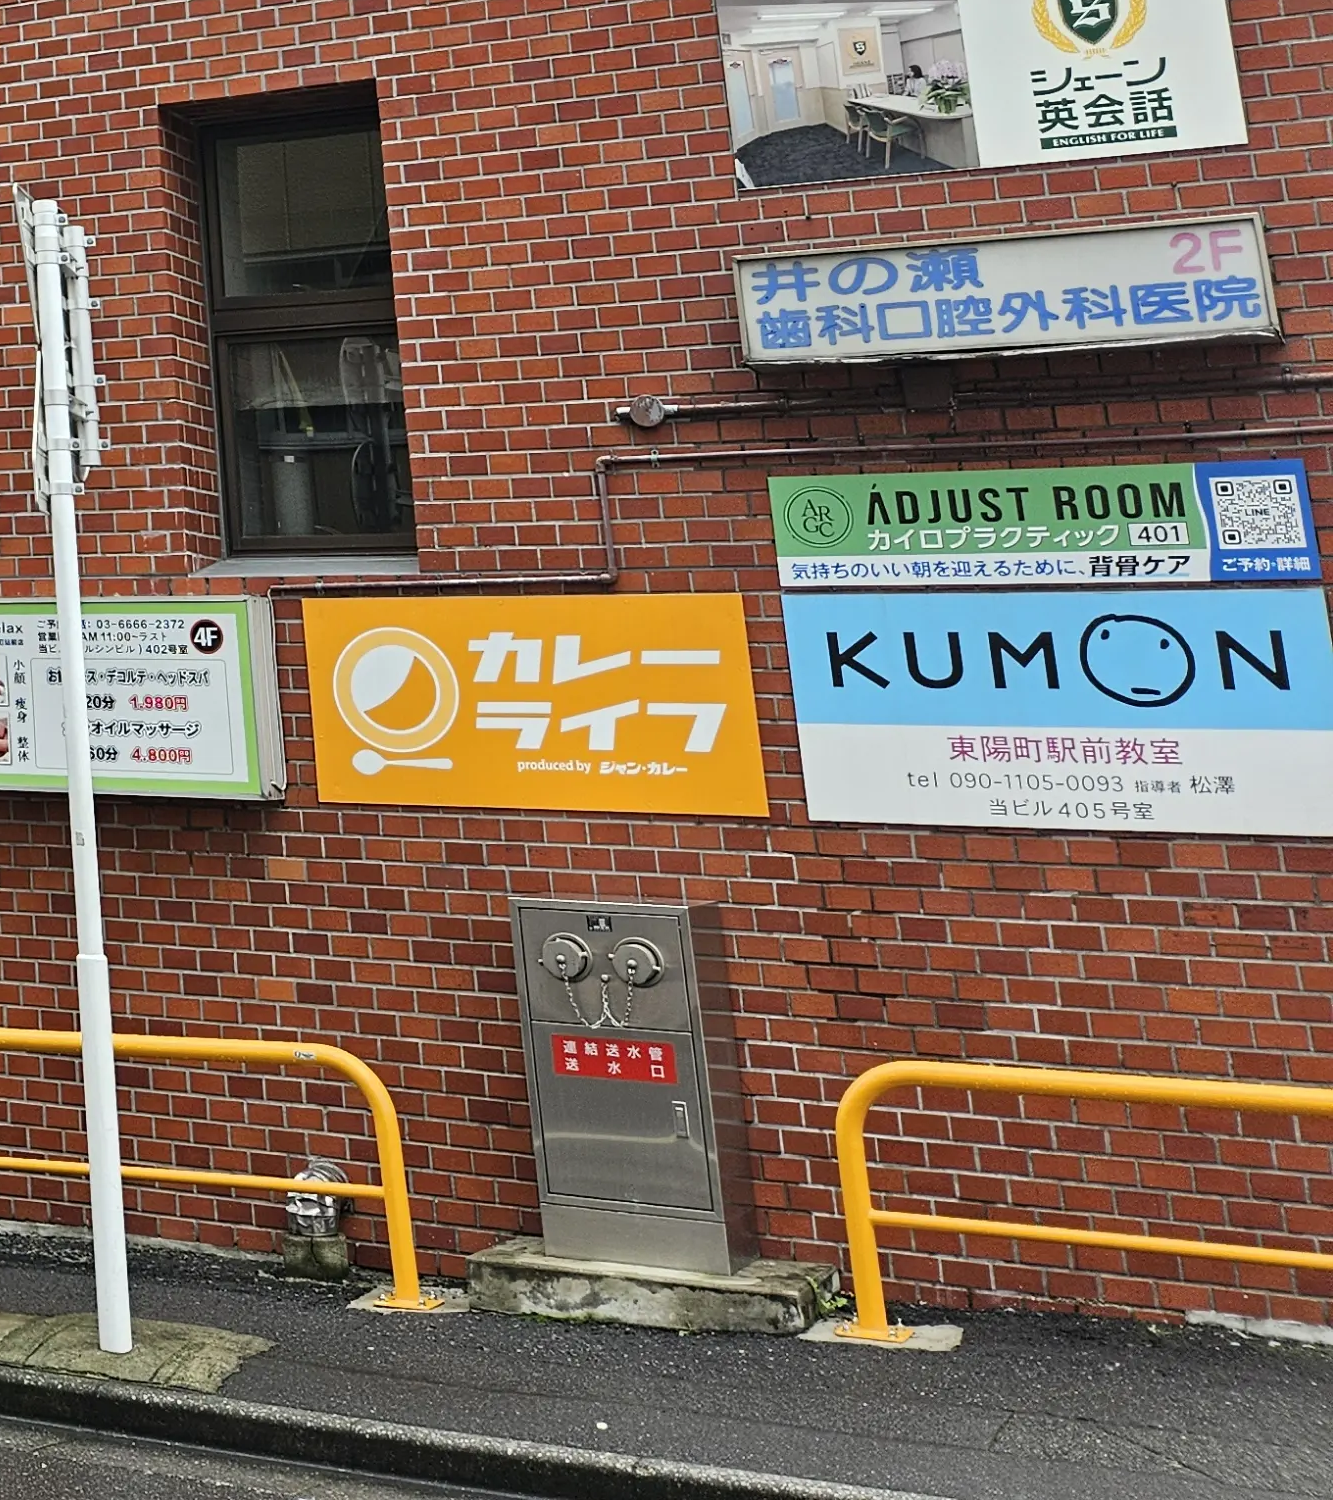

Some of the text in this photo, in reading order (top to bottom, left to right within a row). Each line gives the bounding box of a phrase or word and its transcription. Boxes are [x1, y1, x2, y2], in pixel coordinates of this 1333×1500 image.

[1030, 56, 1167, 97] シェーン
[1035, 87, 1174, 134] 英会話
[1052, 128, 1166, 148] ENGLISH FOR LIFE
[750, 228, 1245, 304] 井の瀬 2F
[760, 276, 1262, 350] 歯科口腔外科医院
[1052, 482, 1186, 521] ROOM
[1244, 507, 1271, 517] LINE
[867, 524, 1182, 551] カイロプラクティック 401
[96, 619, 186, 630] 03-6666-2372
[192, 626, 219, 648] 4F
[467, 631, 721, 685] カレー
[825, 612, 1292, 708] KUMON
[13, 659, 28, 685] 小顔
[474, 698, 728, 752] ライフ
[946, 734, 1184, 767] 東陽町駅前教室
[516, 757, 576, 773] produced
[576, 758, 592, 775] by
[906, 770, 1236, 795] tel 090-1105-0093 指導者 松澤
[988, 798, 1156, 822] 当ビル405号室
[562, 1039, 664, 1063] 連結送水管
[564, 1057, 666, 1080] 送水口
